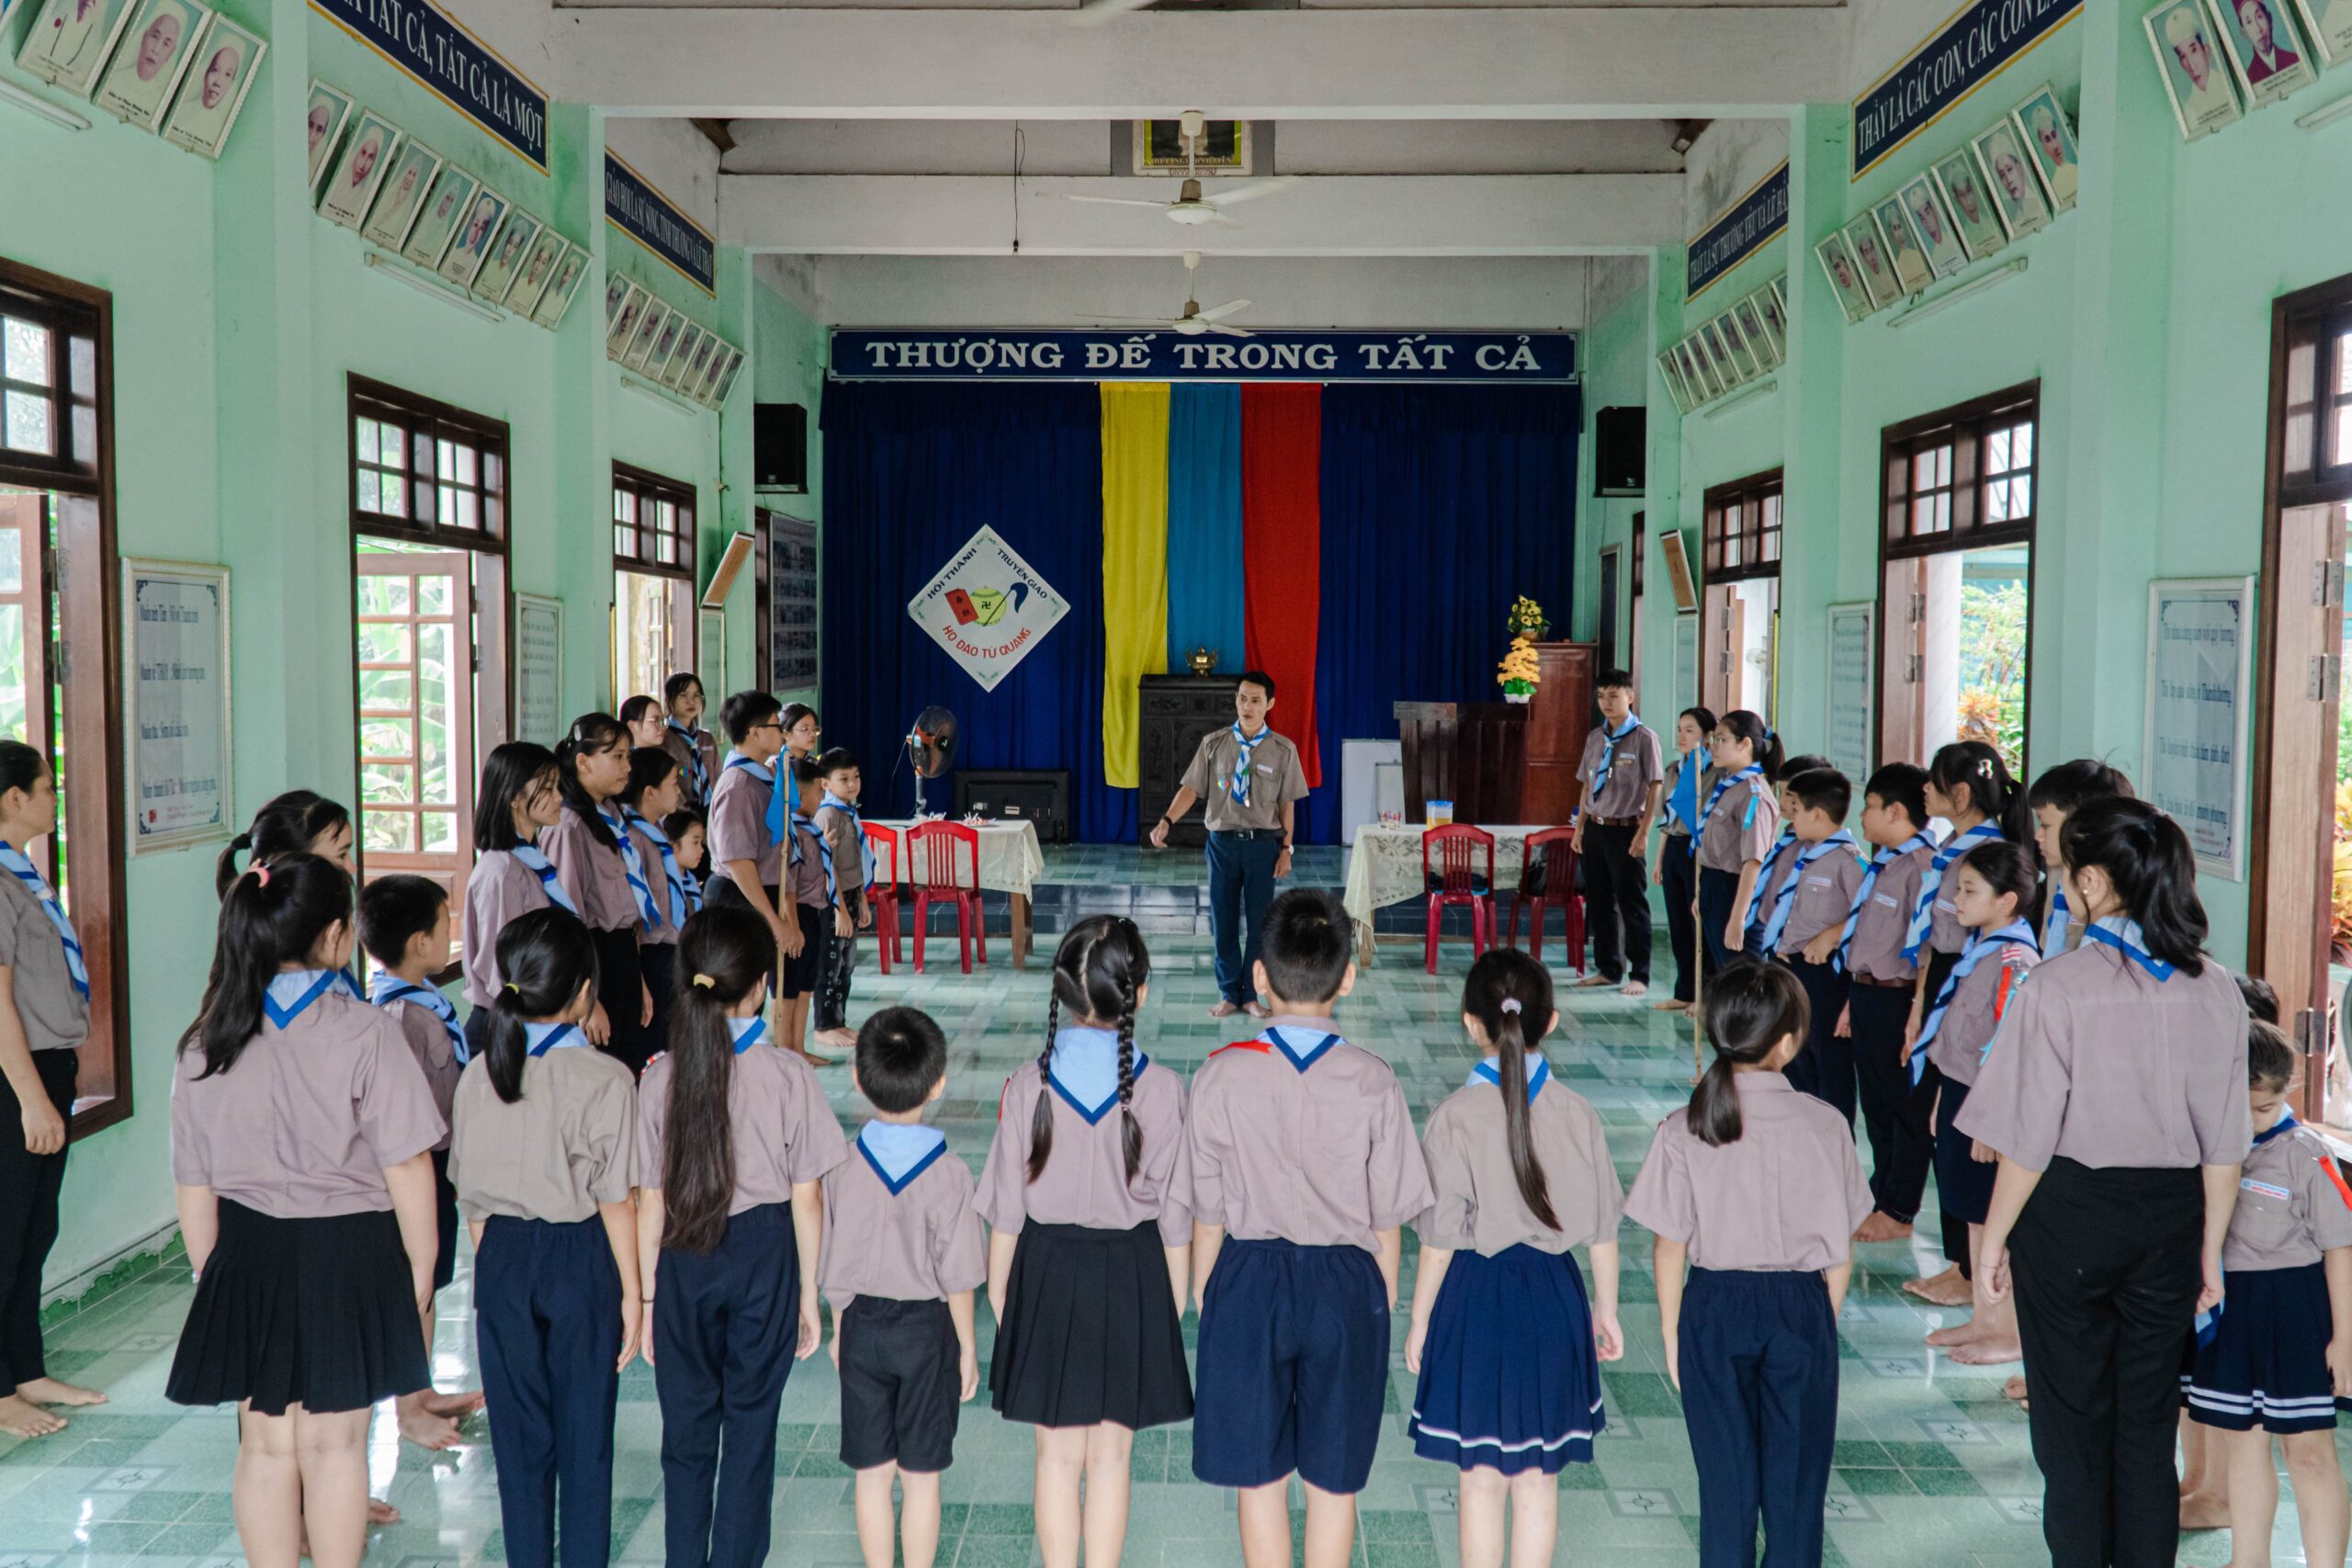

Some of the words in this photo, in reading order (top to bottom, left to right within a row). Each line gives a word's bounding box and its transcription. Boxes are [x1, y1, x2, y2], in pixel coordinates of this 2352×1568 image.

[406, 8, 433, 73] CẢ,
[435, 33, 467, 90] TẤT
[469, 60, 490, 109] CẢ
[493, 77, 511, 126] LÀ
[514, 96, 543, 151] MỘT
[1889, 79, 1905, 130] LÀ
[1906, 62, 1932, 117] CÁC
[1934, 39, 1965, 96] CON,
[1968, 7, 1998, 69] CÁC
[865, 337, 1065, 374] THƯỢNG
[1085, 333, 1157, 369] ĐẾ
[1172, 344, 1339, 370] TRONG
[1358, 334, 1454, 370] TẤT
[1475, 334, 1542, 370] CẢ
[999, 627, 1031, 655] QUANG
